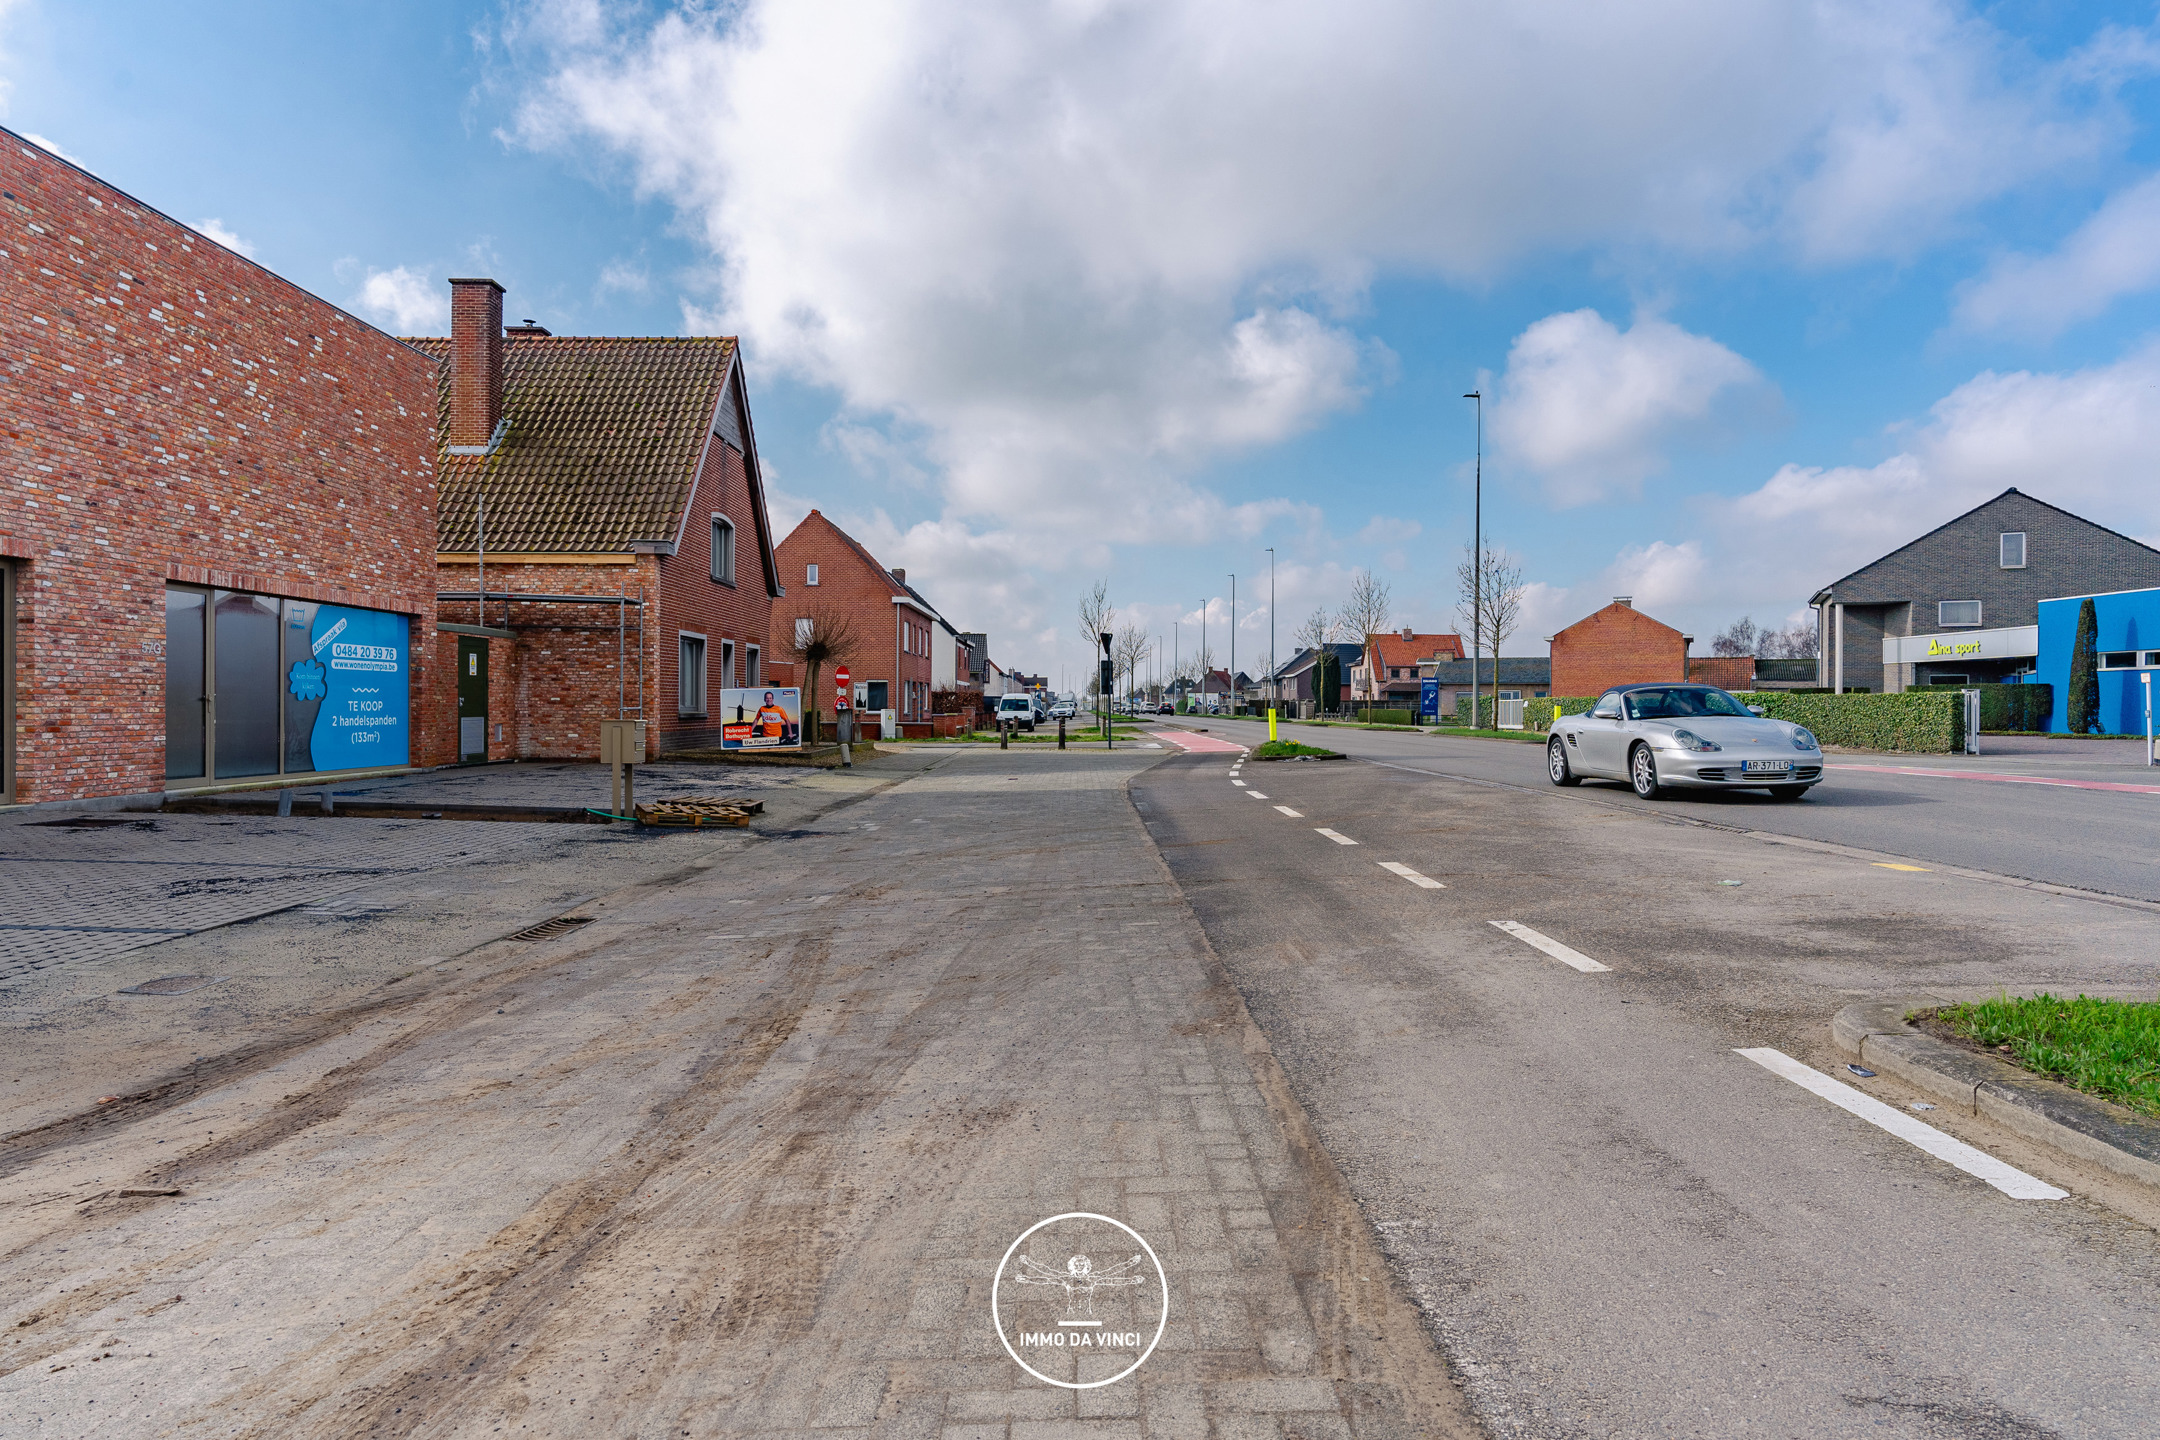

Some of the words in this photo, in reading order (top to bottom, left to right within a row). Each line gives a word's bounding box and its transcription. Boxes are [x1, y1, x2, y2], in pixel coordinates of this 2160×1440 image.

[313, 629, 338, 652] Afspraak
[141, 641, 161, 655] 57G
[336, 644, 358, 656] 0484
[360, 646, 371, 658] 20
[372, 647, 383, 659] 39
[384, 648, 394, 660] 76
[1955, 640, 1981, 657] sport
[334, 661, 396, 670] www.wonenolympia.be
[348, 700, 358, 712] TE
[360, 700, 384, 712] KOOP
[332, 715, 338, 727] 2
[340, 715, 396, 728] handelspanden
